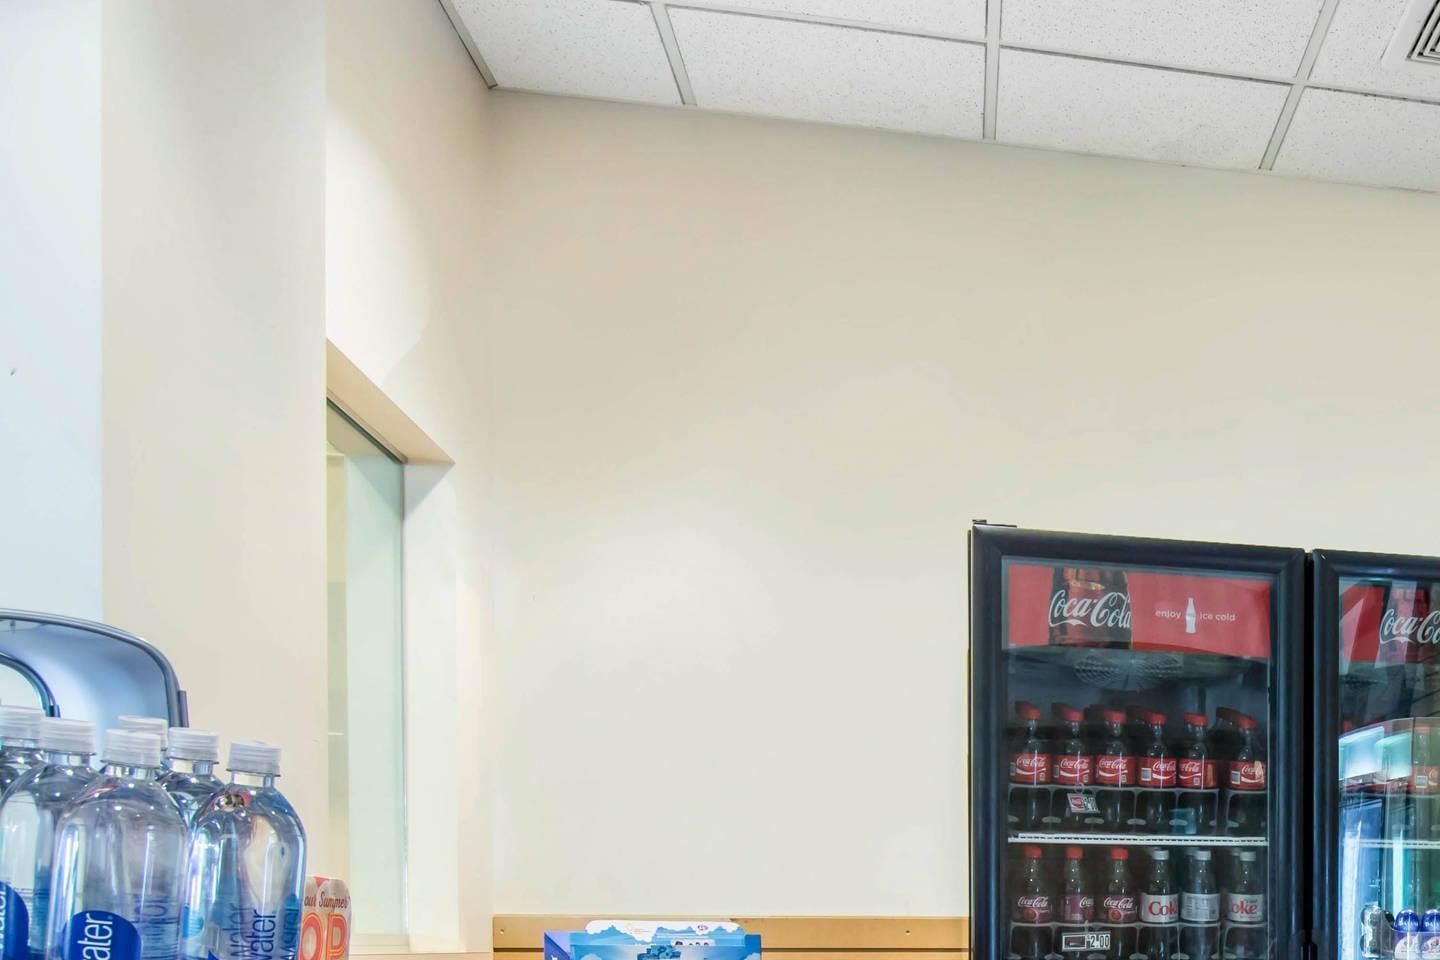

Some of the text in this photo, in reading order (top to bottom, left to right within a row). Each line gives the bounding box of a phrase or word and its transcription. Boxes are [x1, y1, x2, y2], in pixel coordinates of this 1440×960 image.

[1048, 589, 1131, 628] Coca-Cola
[1155, 609, 1236, 622] enjoy ice cold
[1016, 756, 1047, 769] Coca-Cola
[1060, 757, 1089, 770] Coca-Cola
[1148, 901, 1176, 916] Cok
[1232, 902, 1257, 915] oke
